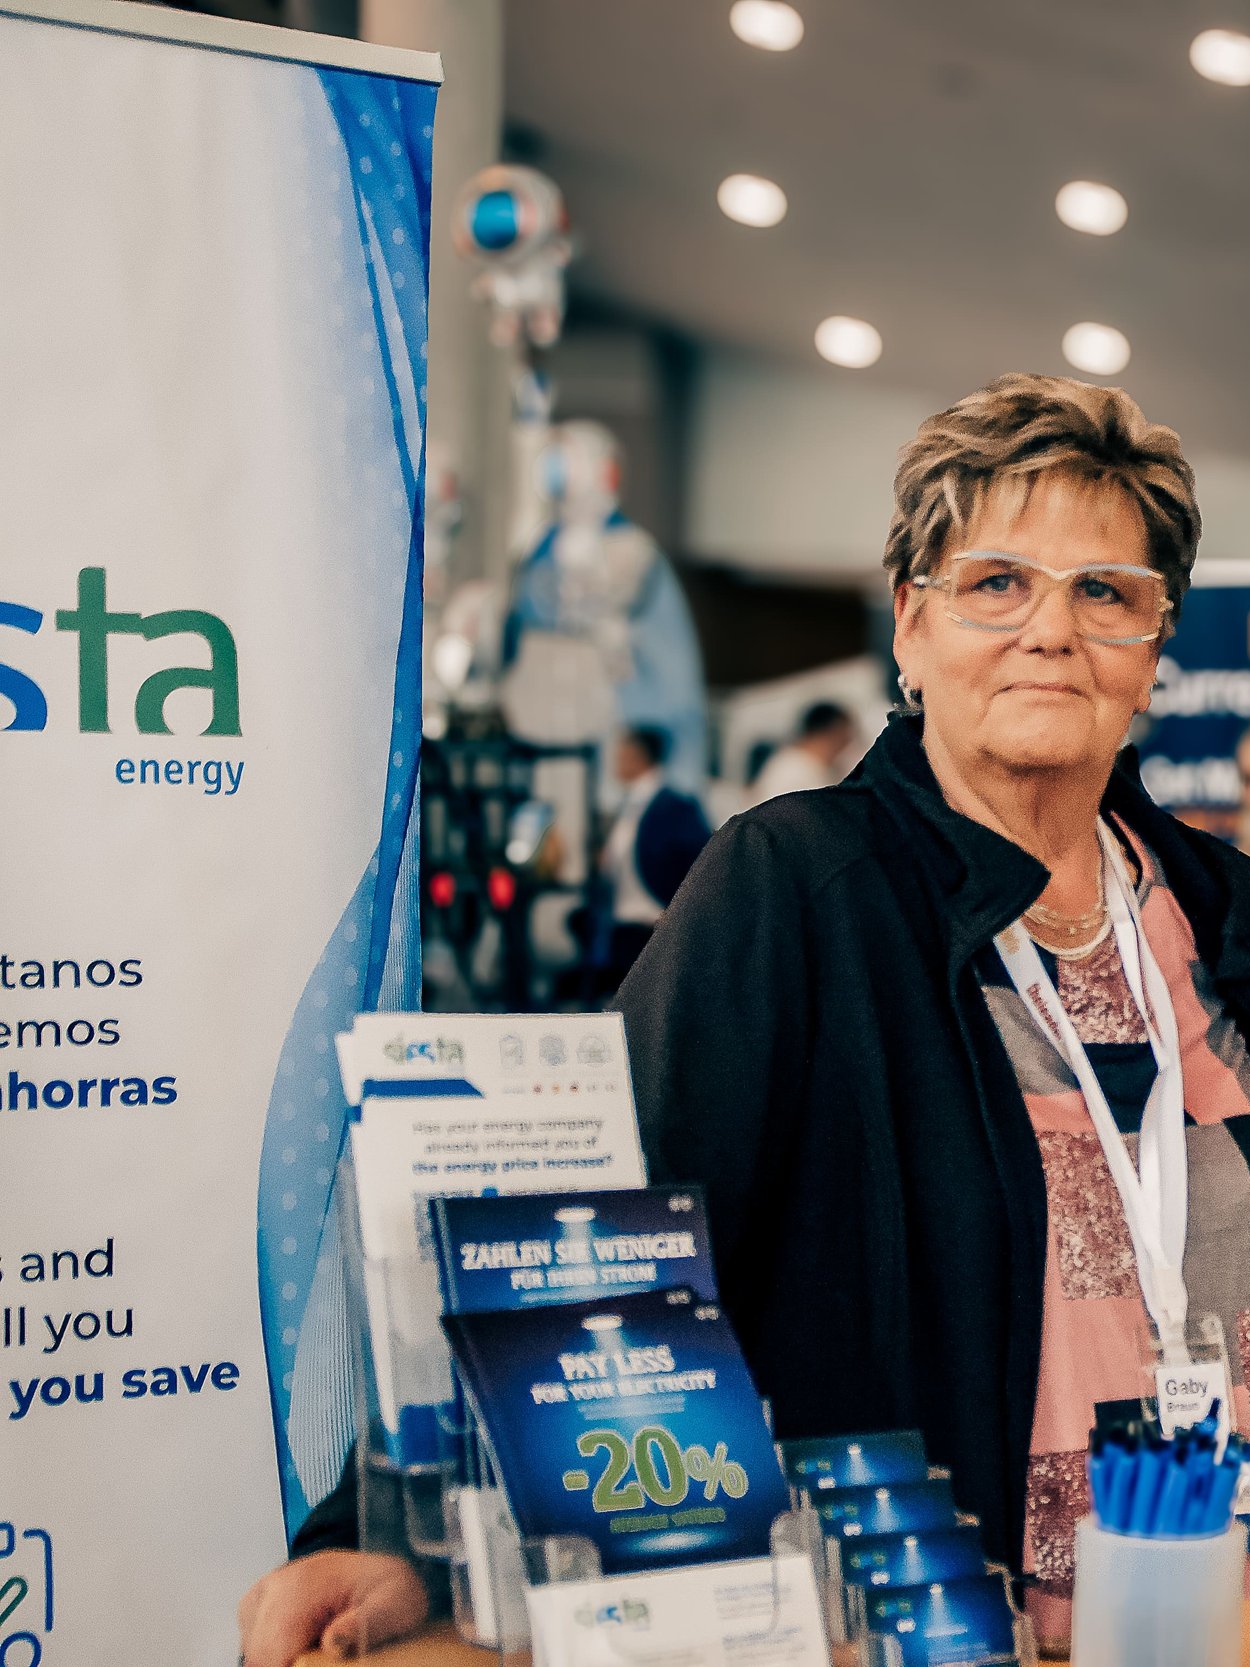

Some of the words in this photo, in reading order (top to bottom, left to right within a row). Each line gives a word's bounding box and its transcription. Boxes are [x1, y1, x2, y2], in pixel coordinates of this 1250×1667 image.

[115, 758, 245, 796] energy
[0, 1069, 178, 1111] horras
[19, 1236, 115, 1283] and
[460, 1238, 552, 1271] ZAHLEN
[42, 1307, 134, 1354] you
[557, 1350, 609, 1381] PAY
[612, 1344, 676, 1376] LESS
[8, 1371, 105, 1421] you
[121, 1360, 241, 1400] save
[1165, 1378, 1209, 1398] Gaby
[562, 1424, 749, 1513] -20%
